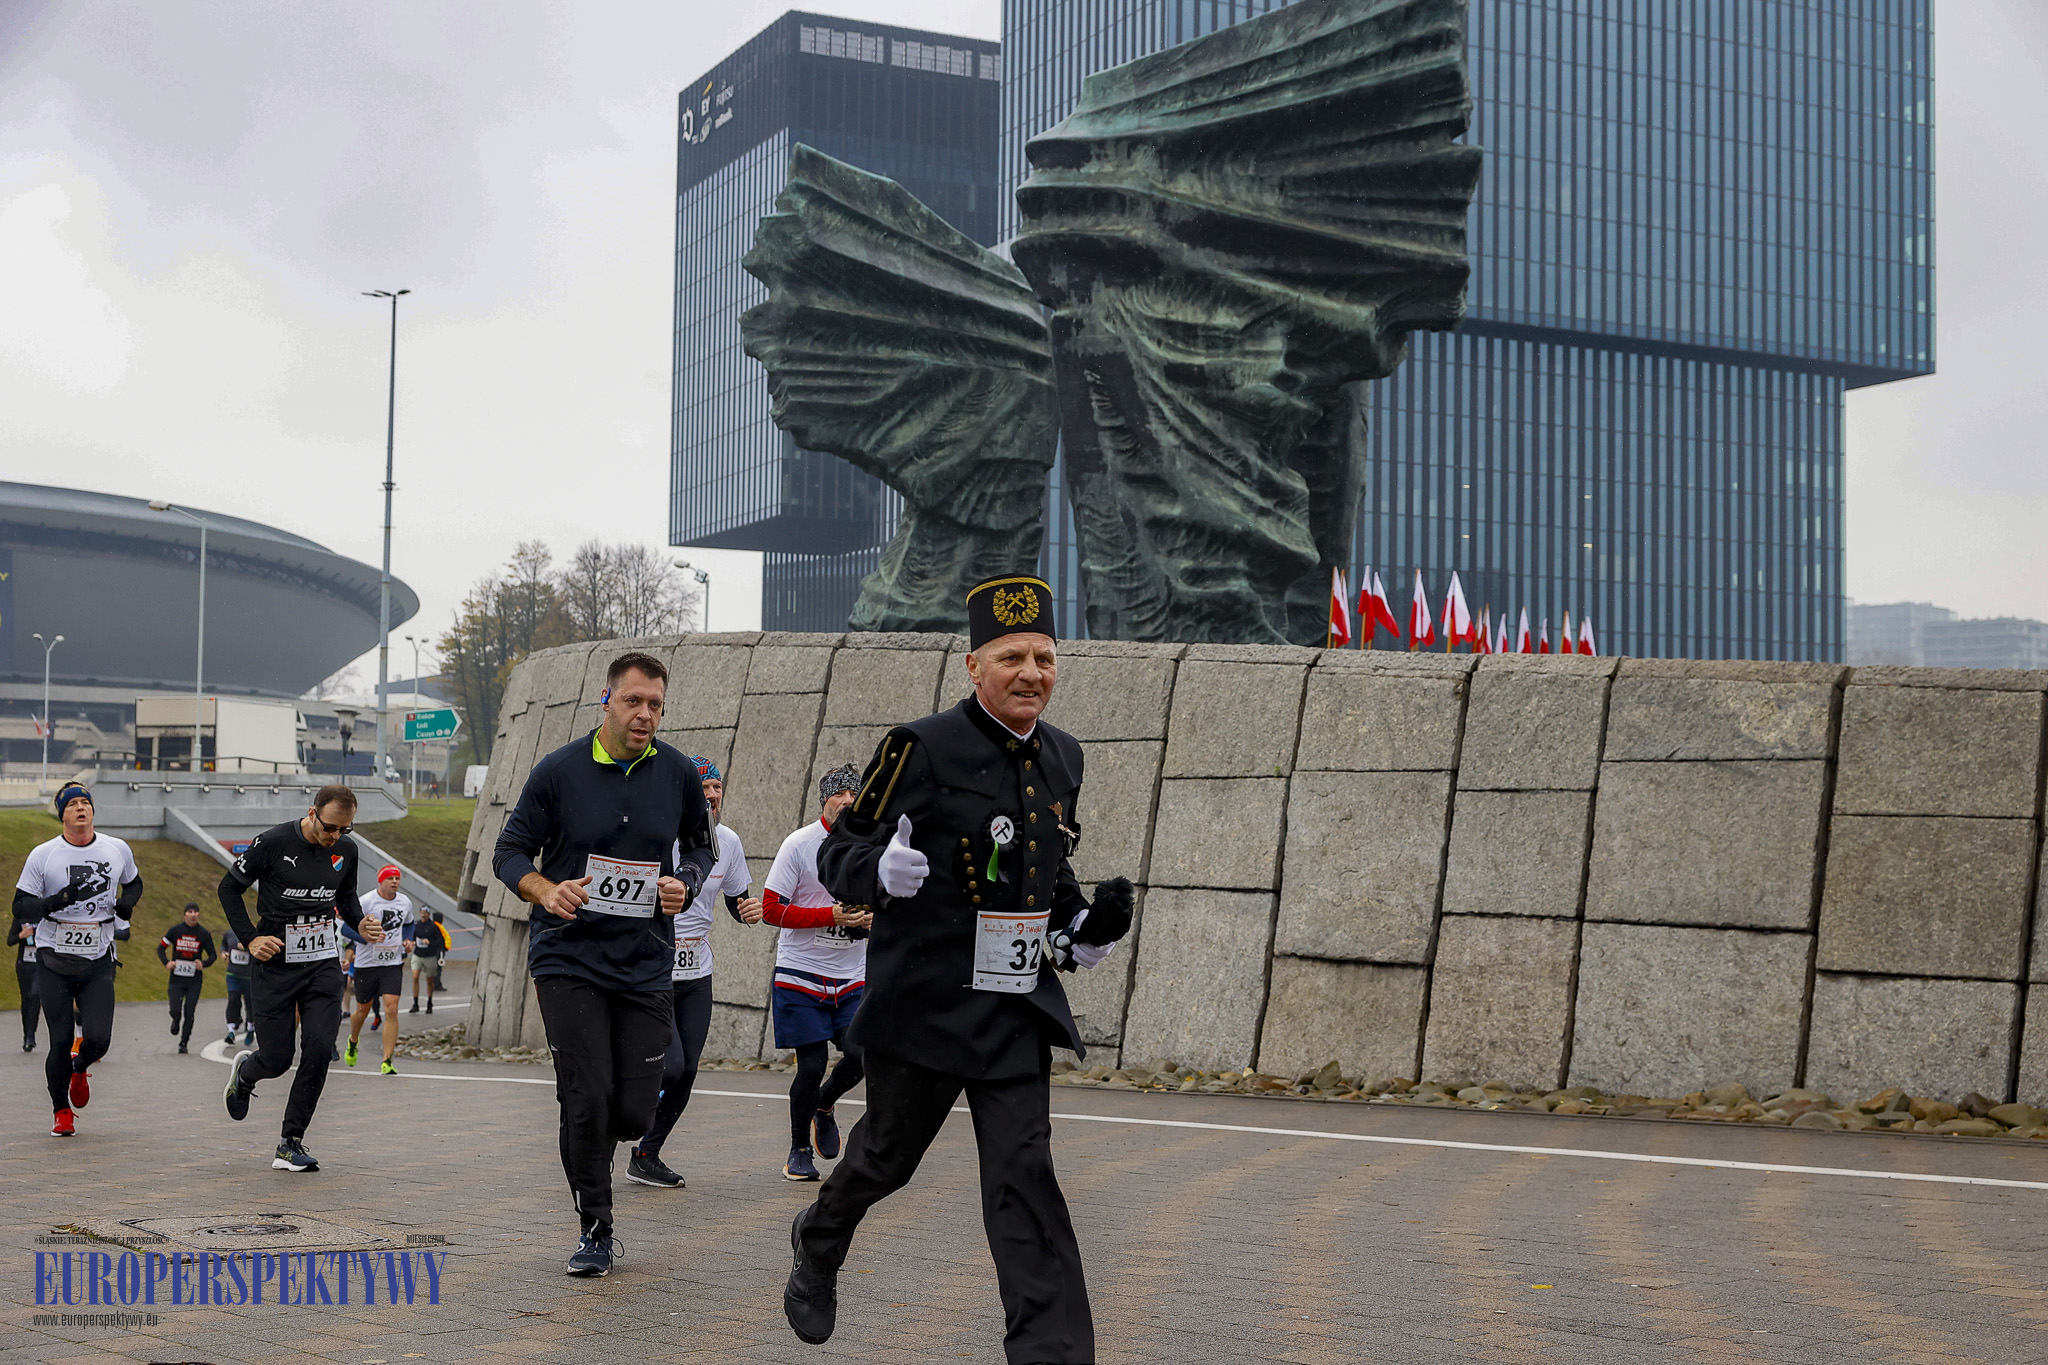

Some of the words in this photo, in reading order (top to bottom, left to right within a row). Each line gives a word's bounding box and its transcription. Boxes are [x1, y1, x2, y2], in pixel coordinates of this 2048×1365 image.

[599, 876, 646, 901] 697
[85, 902, 97, 916] 9
[65, 931, 92, 945] 226
[826, 926, 848, 937] 48
[297, 933, 326, 951] 414
[674, 951, 694, 968] 83
[1009, 938, 1041, 971] 32
